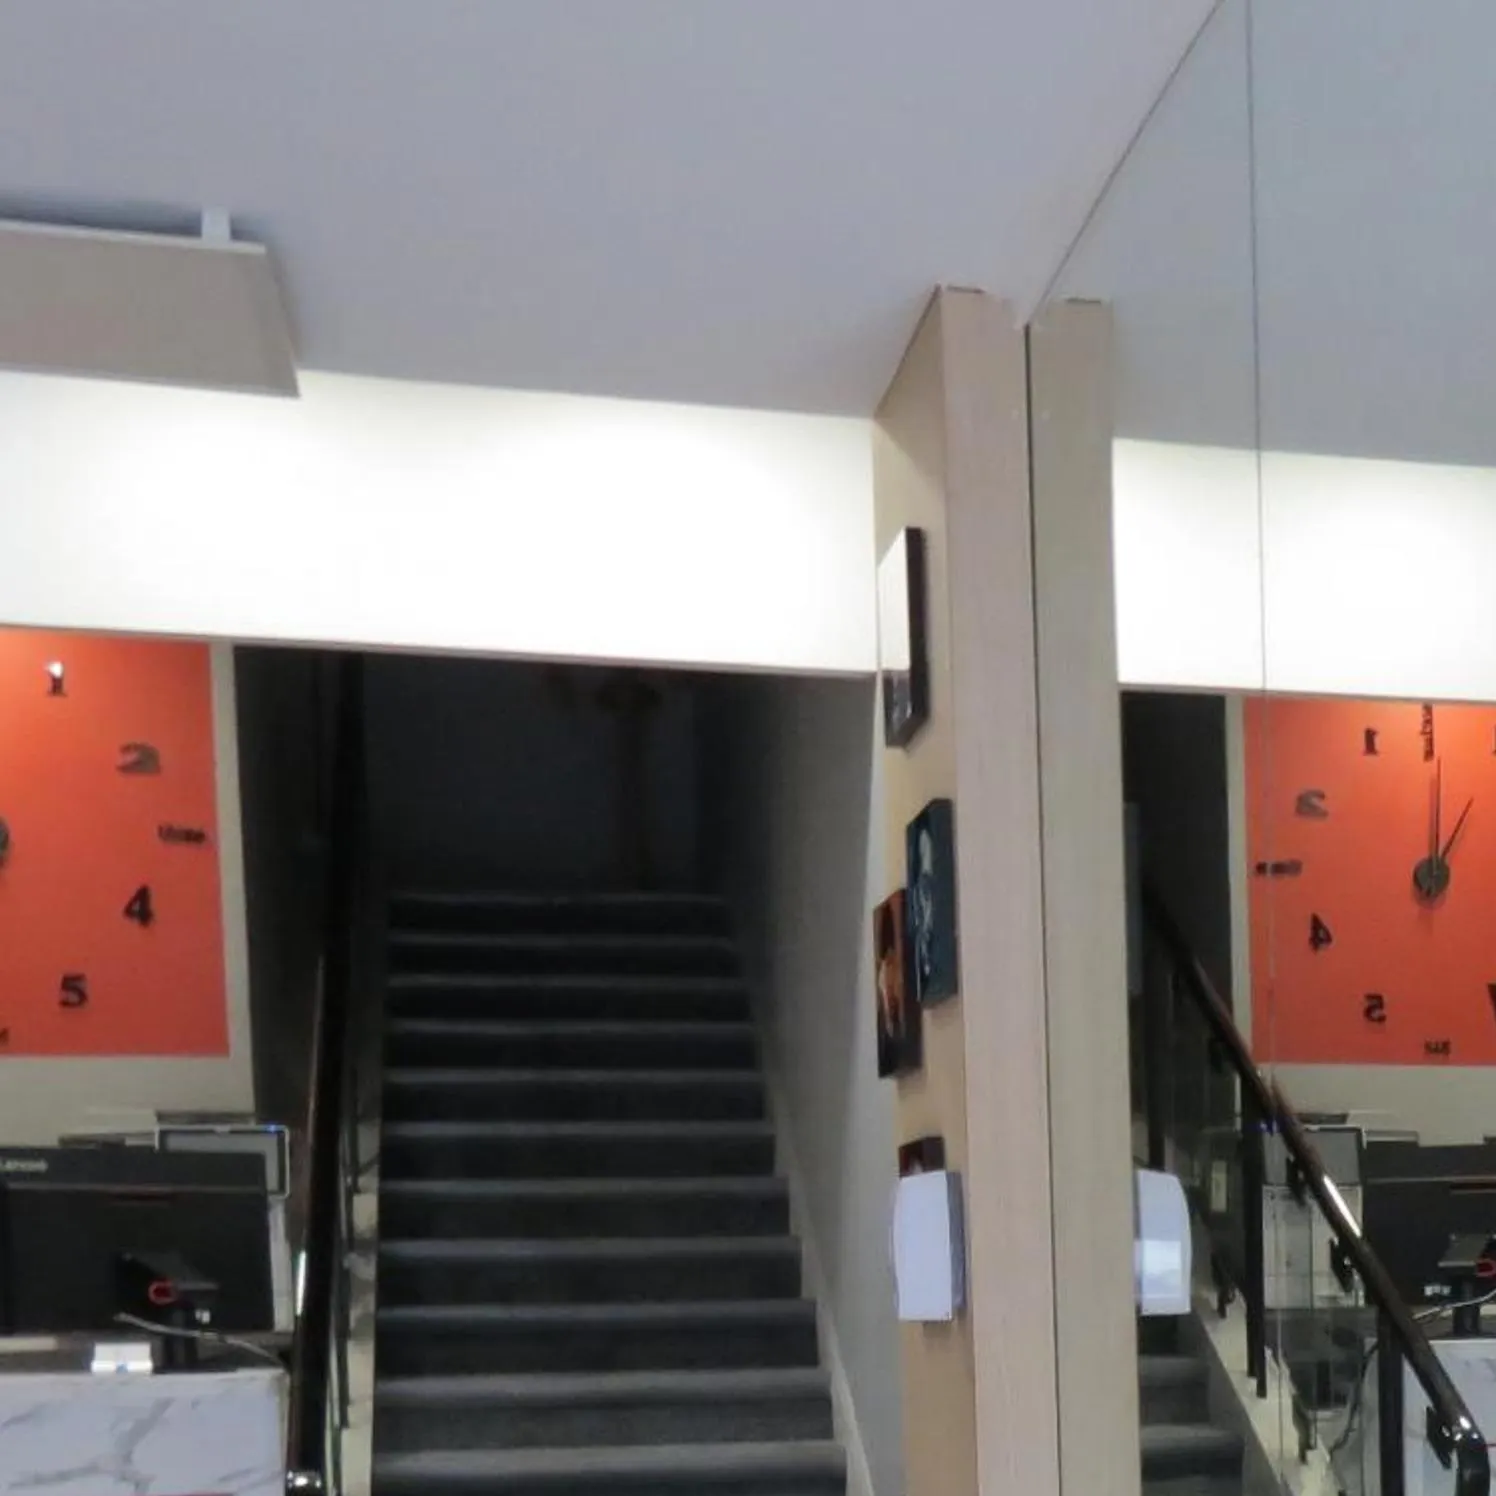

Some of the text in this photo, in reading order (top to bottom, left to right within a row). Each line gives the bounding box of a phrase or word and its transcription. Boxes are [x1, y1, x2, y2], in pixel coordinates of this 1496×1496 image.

[45, 661, 68, 698] 1
[116, 742, 162, 775] 2
[123, 885, 154, 928] 4
[59, 973, 89, 1009] 5
